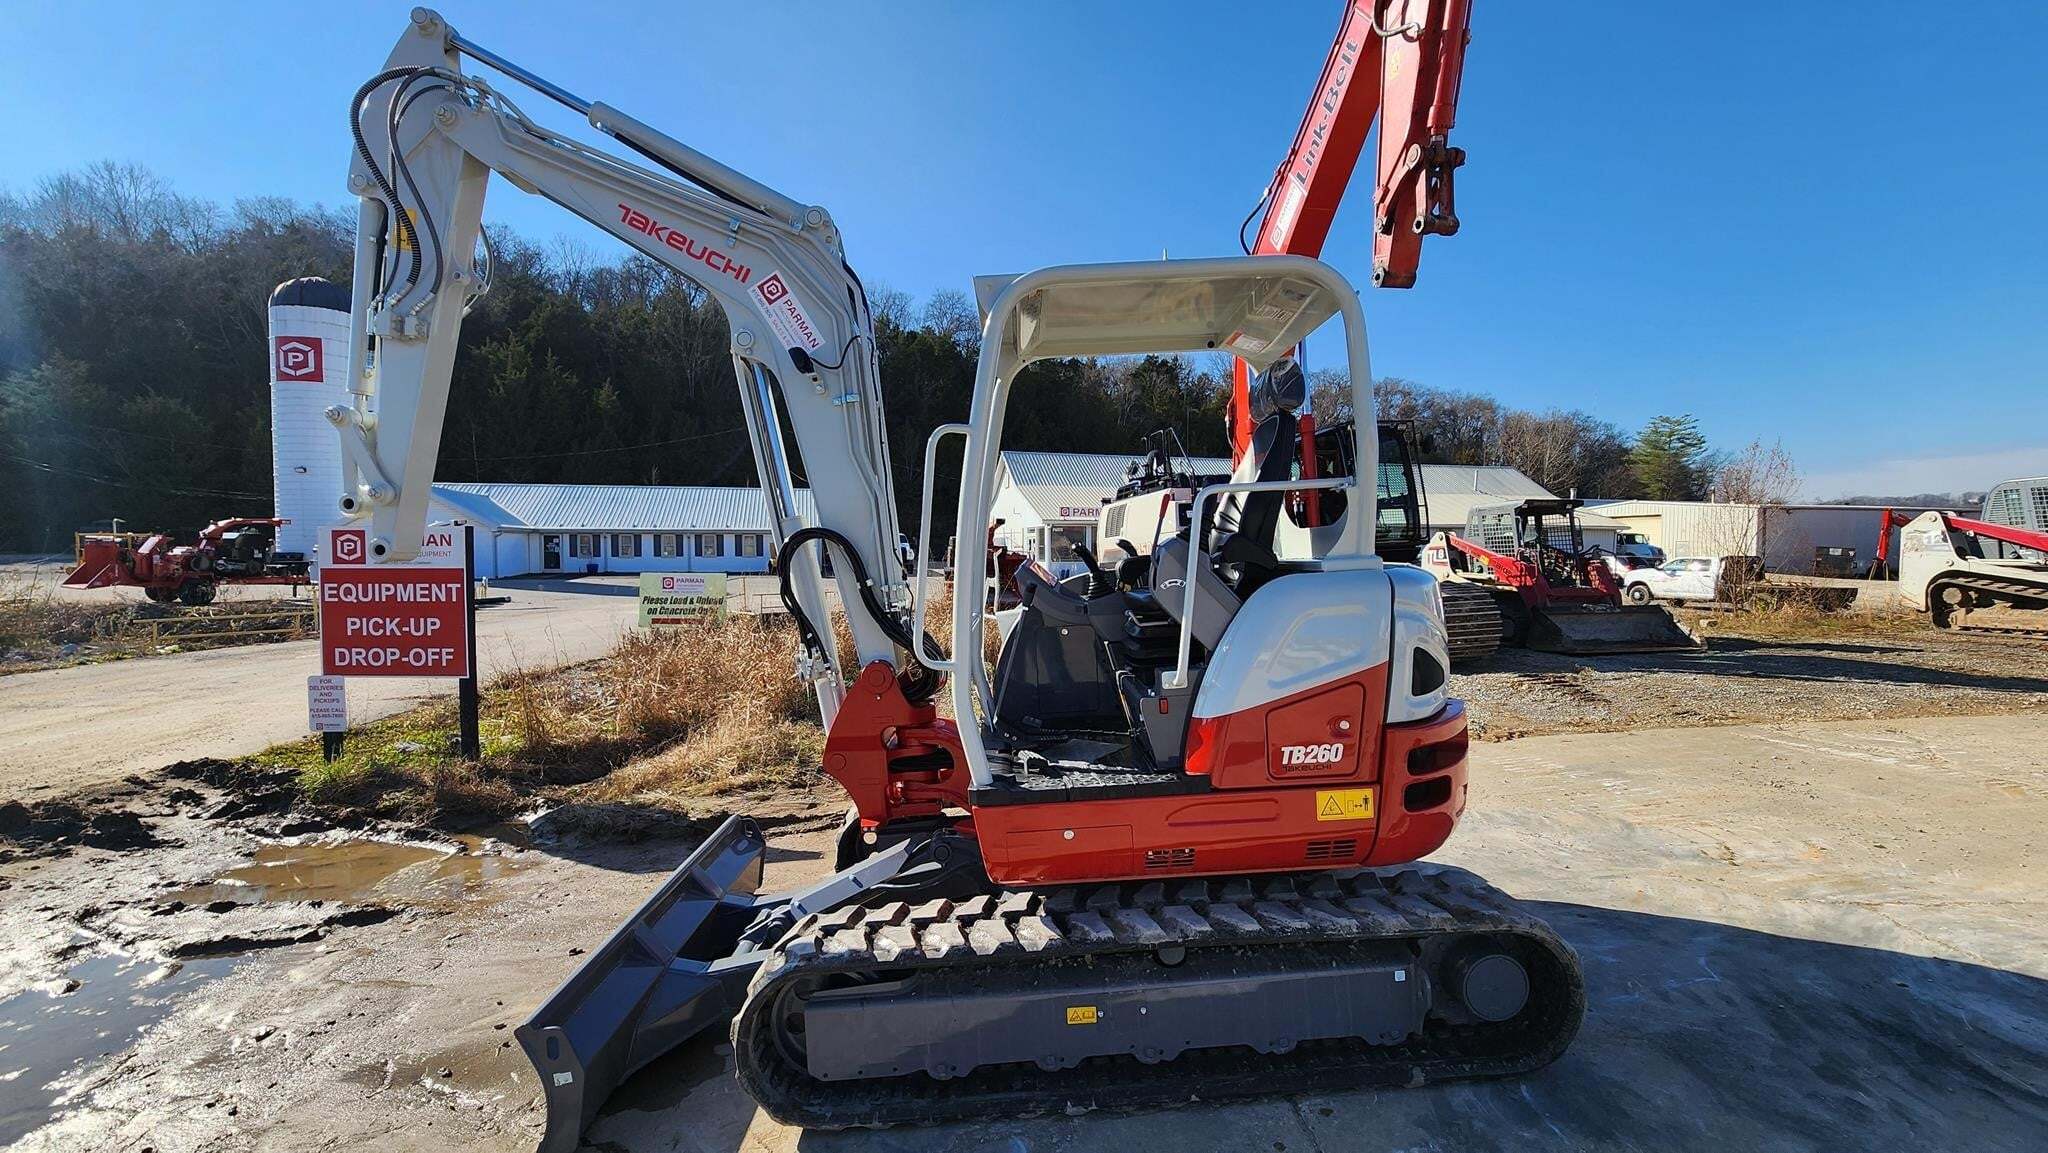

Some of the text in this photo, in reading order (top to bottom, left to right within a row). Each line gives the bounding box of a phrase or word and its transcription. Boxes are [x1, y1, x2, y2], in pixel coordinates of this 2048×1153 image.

[1295, 39, 1358, 185] Link-Belt
[783, 299, 820, 348] PARMAN
[1073, 508, 1101, 516] PARM
[324, 583, 461, 603] EQUIPMENT
[642, 596, 668, 605] Please
[669, 596, 688, 605] Load
[647, 607, 658, 615] on
[346, 617, 441, 636] PICK-UP
[334, 647, 455, 667] DROP-OFF
[1281, 743, 1344, 765] TB260
